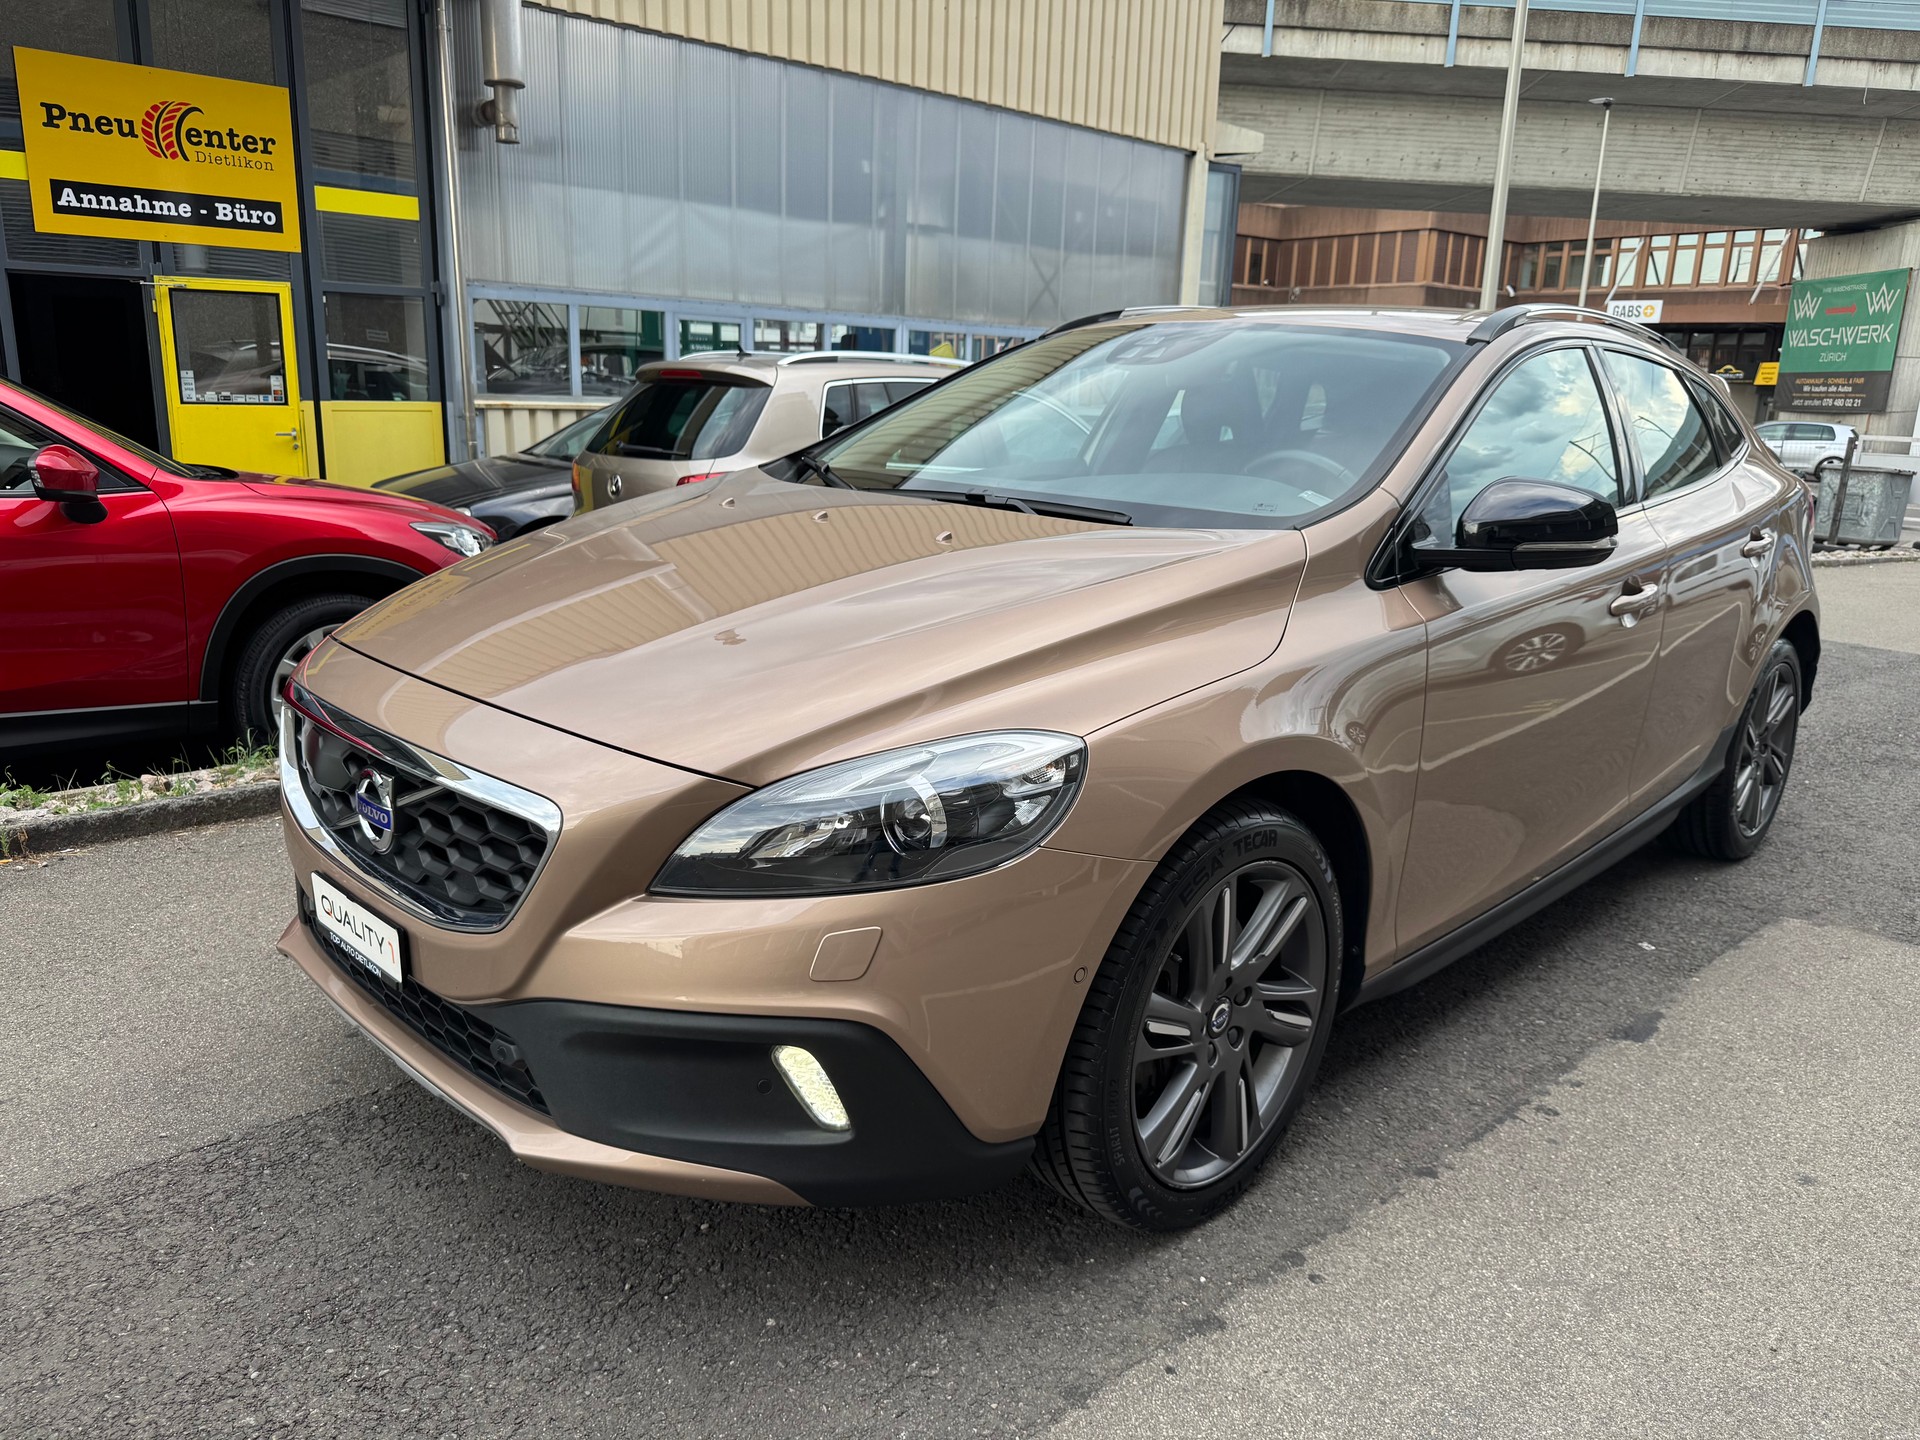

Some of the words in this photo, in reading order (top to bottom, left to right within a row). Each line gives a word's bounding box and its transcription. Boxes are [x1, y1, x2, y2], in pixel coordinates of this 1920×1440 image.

[39, 101, 139, 139] Pneu
[194, 150, 275, 172] Dietlikon
[57, 187, 193, 218] Annahme
[215, 202, 277, 226] Büro
[1612, 305, 1642, 318] GABS
[1788, 323, 1894, 348] WASCHWERK
[1819, 352, 1847, 362] ZÜRICH
[358, 801, 389, 825] VOLVO
[1233, 829, 1278, 857] TECAR
[321, 894, 385, 955] QUALITY
[329, 931, 341, 945] TOP
[340, 941, 356, 957] AUTO
